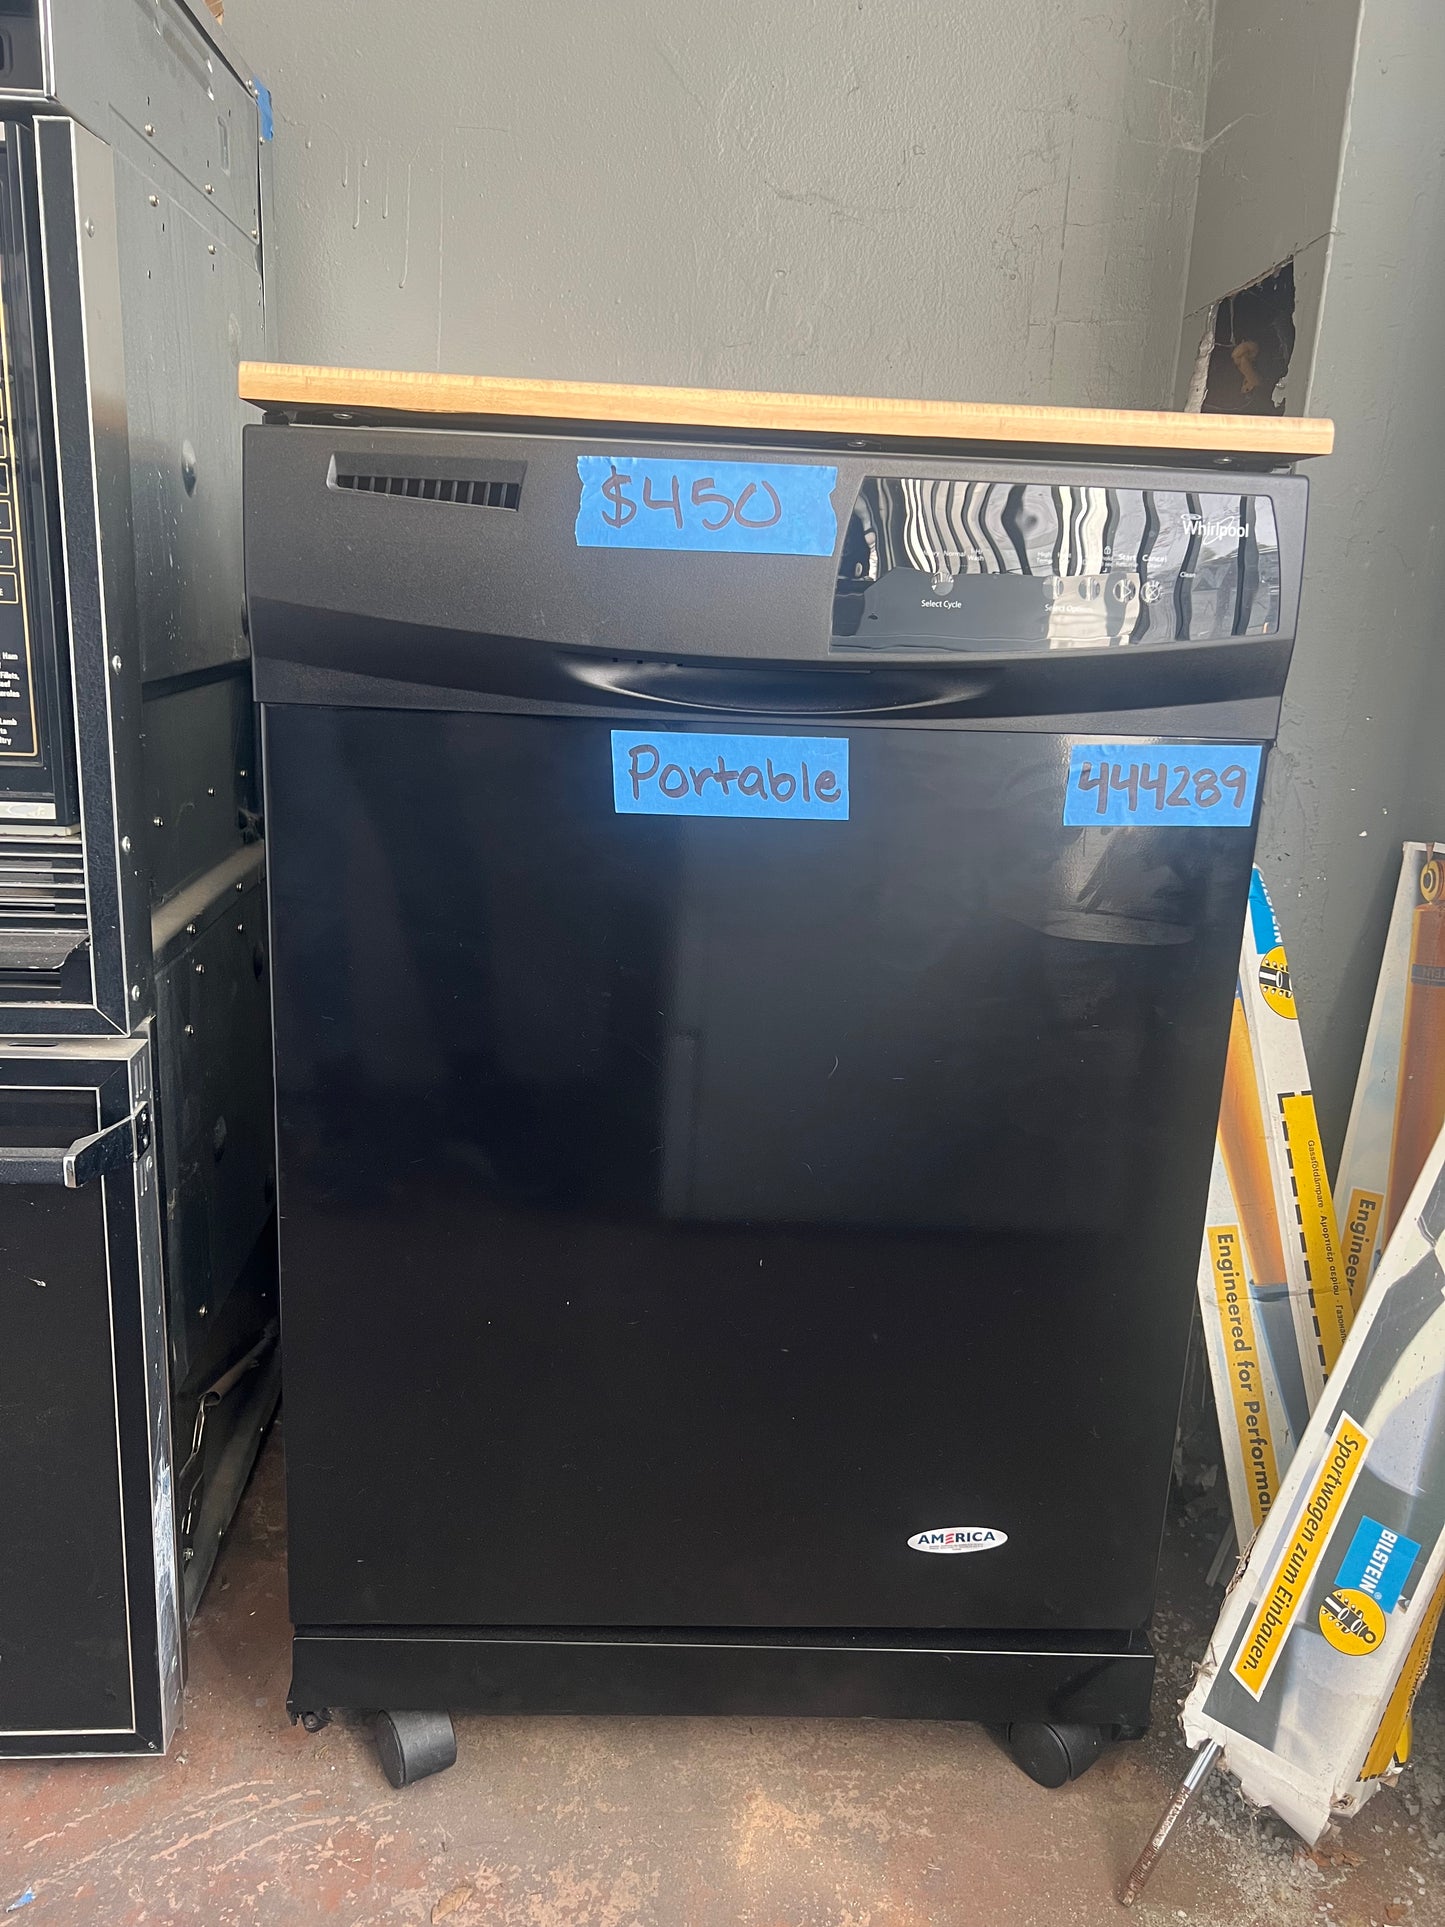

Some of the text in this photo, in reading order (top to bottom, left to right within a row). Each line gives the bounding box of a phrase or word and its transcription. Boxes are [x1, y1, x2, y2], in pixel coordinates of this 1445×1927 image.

[601, 465, 781, 530] $450
[1118, 553, 1136, 561] Start
[1182, 519, 1250, 541] Whirlpool
[1142, 554, 1167, 562] Cancel
[921, 599, 962, 610] Select Cycle
[627, 743, 841, 804] Portable
[1077, 761, 1247, 815] 444289
[1217, 1233, 1253, 1352] Engineered
[1236, 1359, 1255, 1392] for
[918, 1531, 995, 1544] AMERICA
[1242, 1434, 1359, 1670] Sportwagen zum Einbauen.
[1358, 1529, 1400, 1597] BILSTEIN
